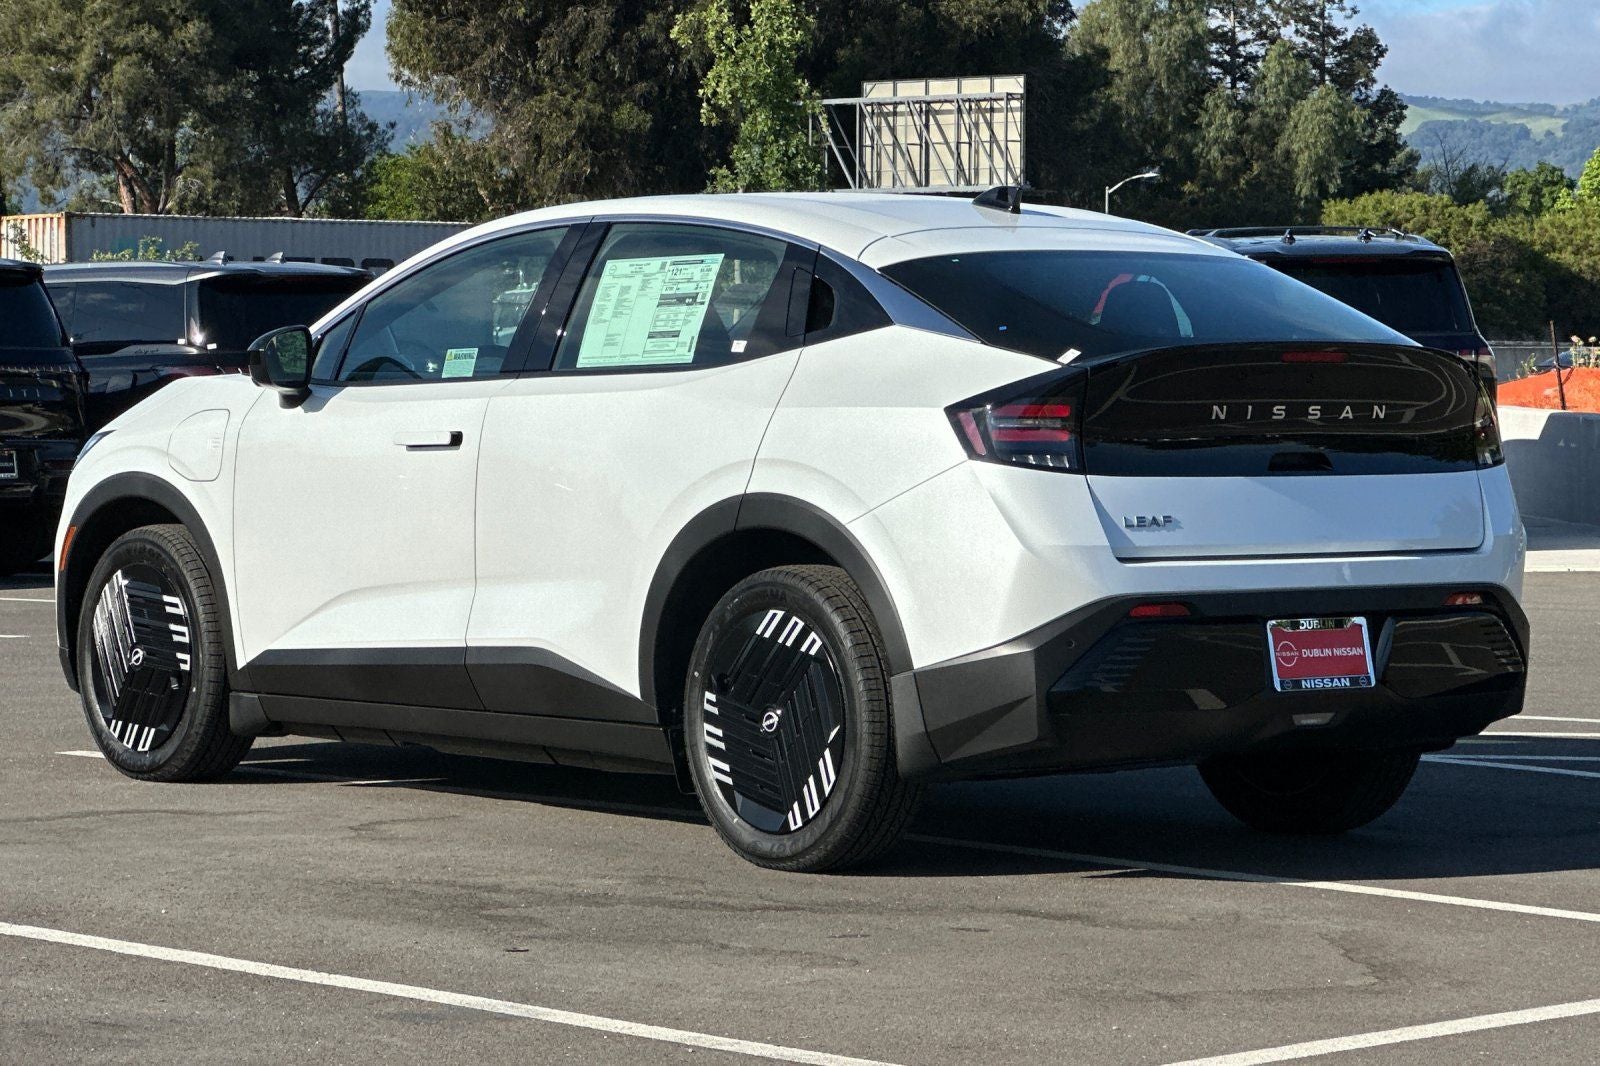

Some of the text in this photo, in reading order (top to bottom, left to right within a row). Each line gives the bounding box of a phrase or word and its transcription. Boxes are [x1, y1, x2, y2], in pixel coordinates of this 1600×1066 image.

[1211, 405, 1386, 420] NISSAN
[1122, 515, 1173, 528] LEAF
[1299, 620, 1335, 629] DUBLIN
[1301, 647, 1364, 657] DUBLIN NISSAN
[1301, 678, 1350, 689] NISSAN
